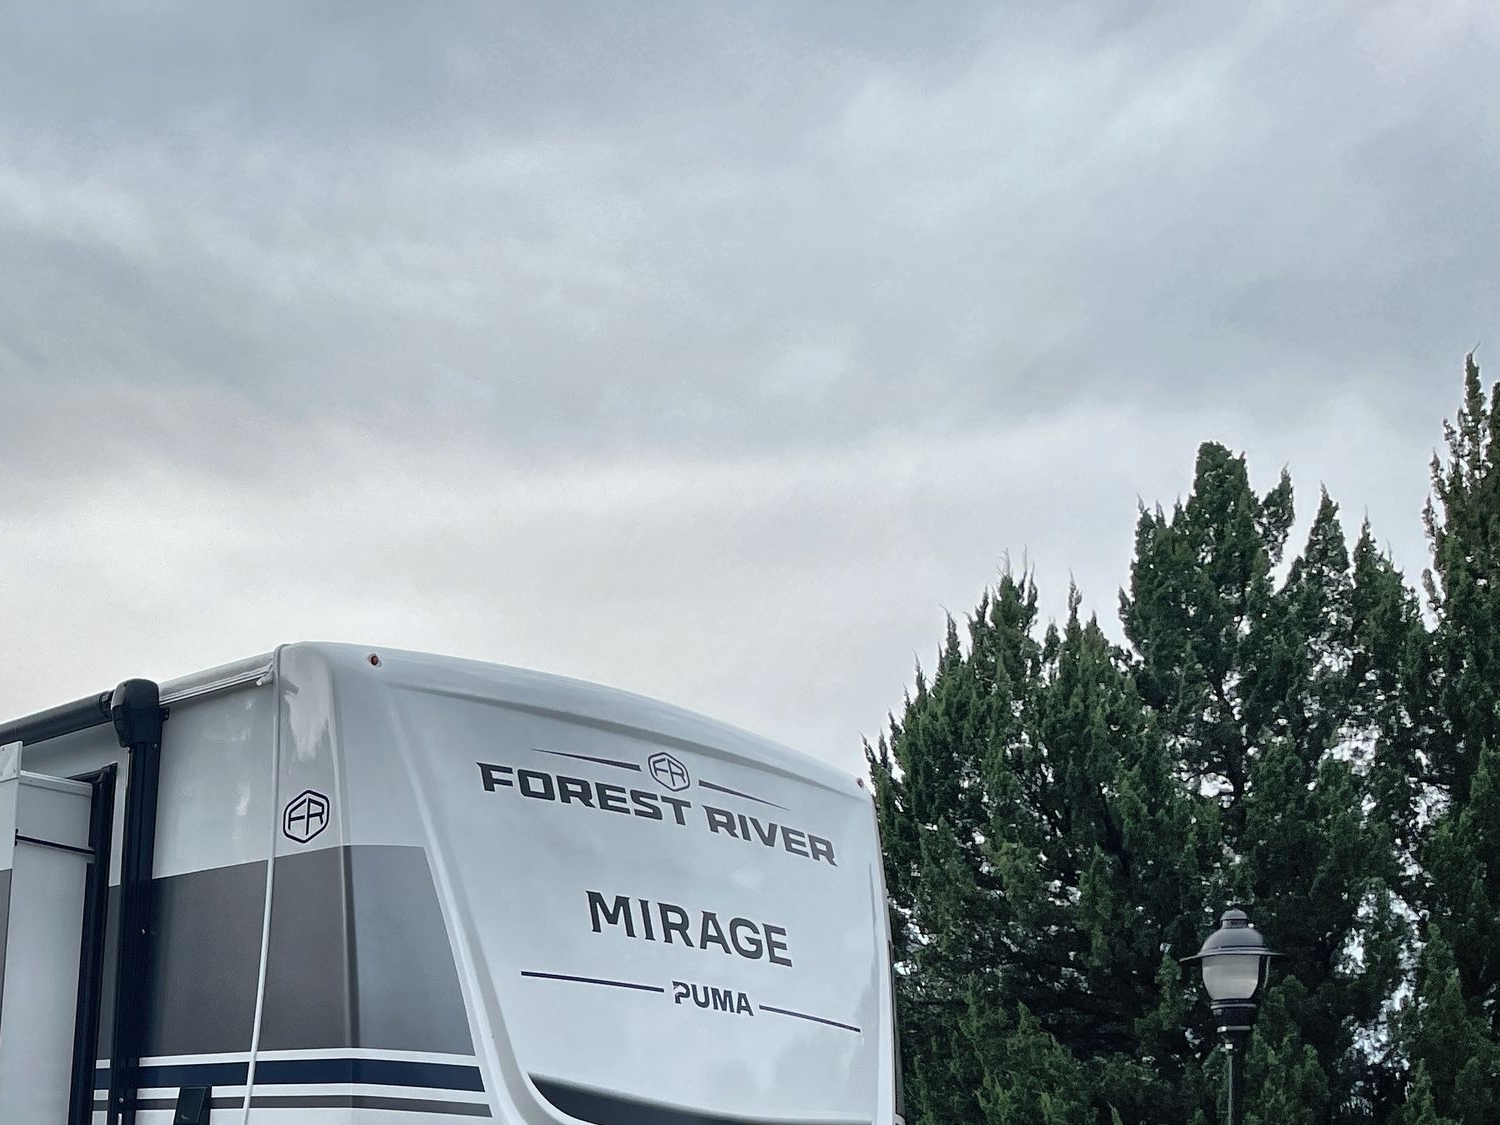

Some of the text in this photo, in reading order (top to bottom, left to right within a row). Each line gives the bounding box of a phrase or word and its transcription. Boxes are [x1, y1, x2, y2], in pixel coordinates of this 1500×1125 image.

[651, 756, 687, 788] FR
[287, 797, 325, 836] FR
[475, 761, 838, 867] FOREST RIVER
[585, 890, 793, 968] MIRAGE
[671, 980, 755, 1017] PUMA
